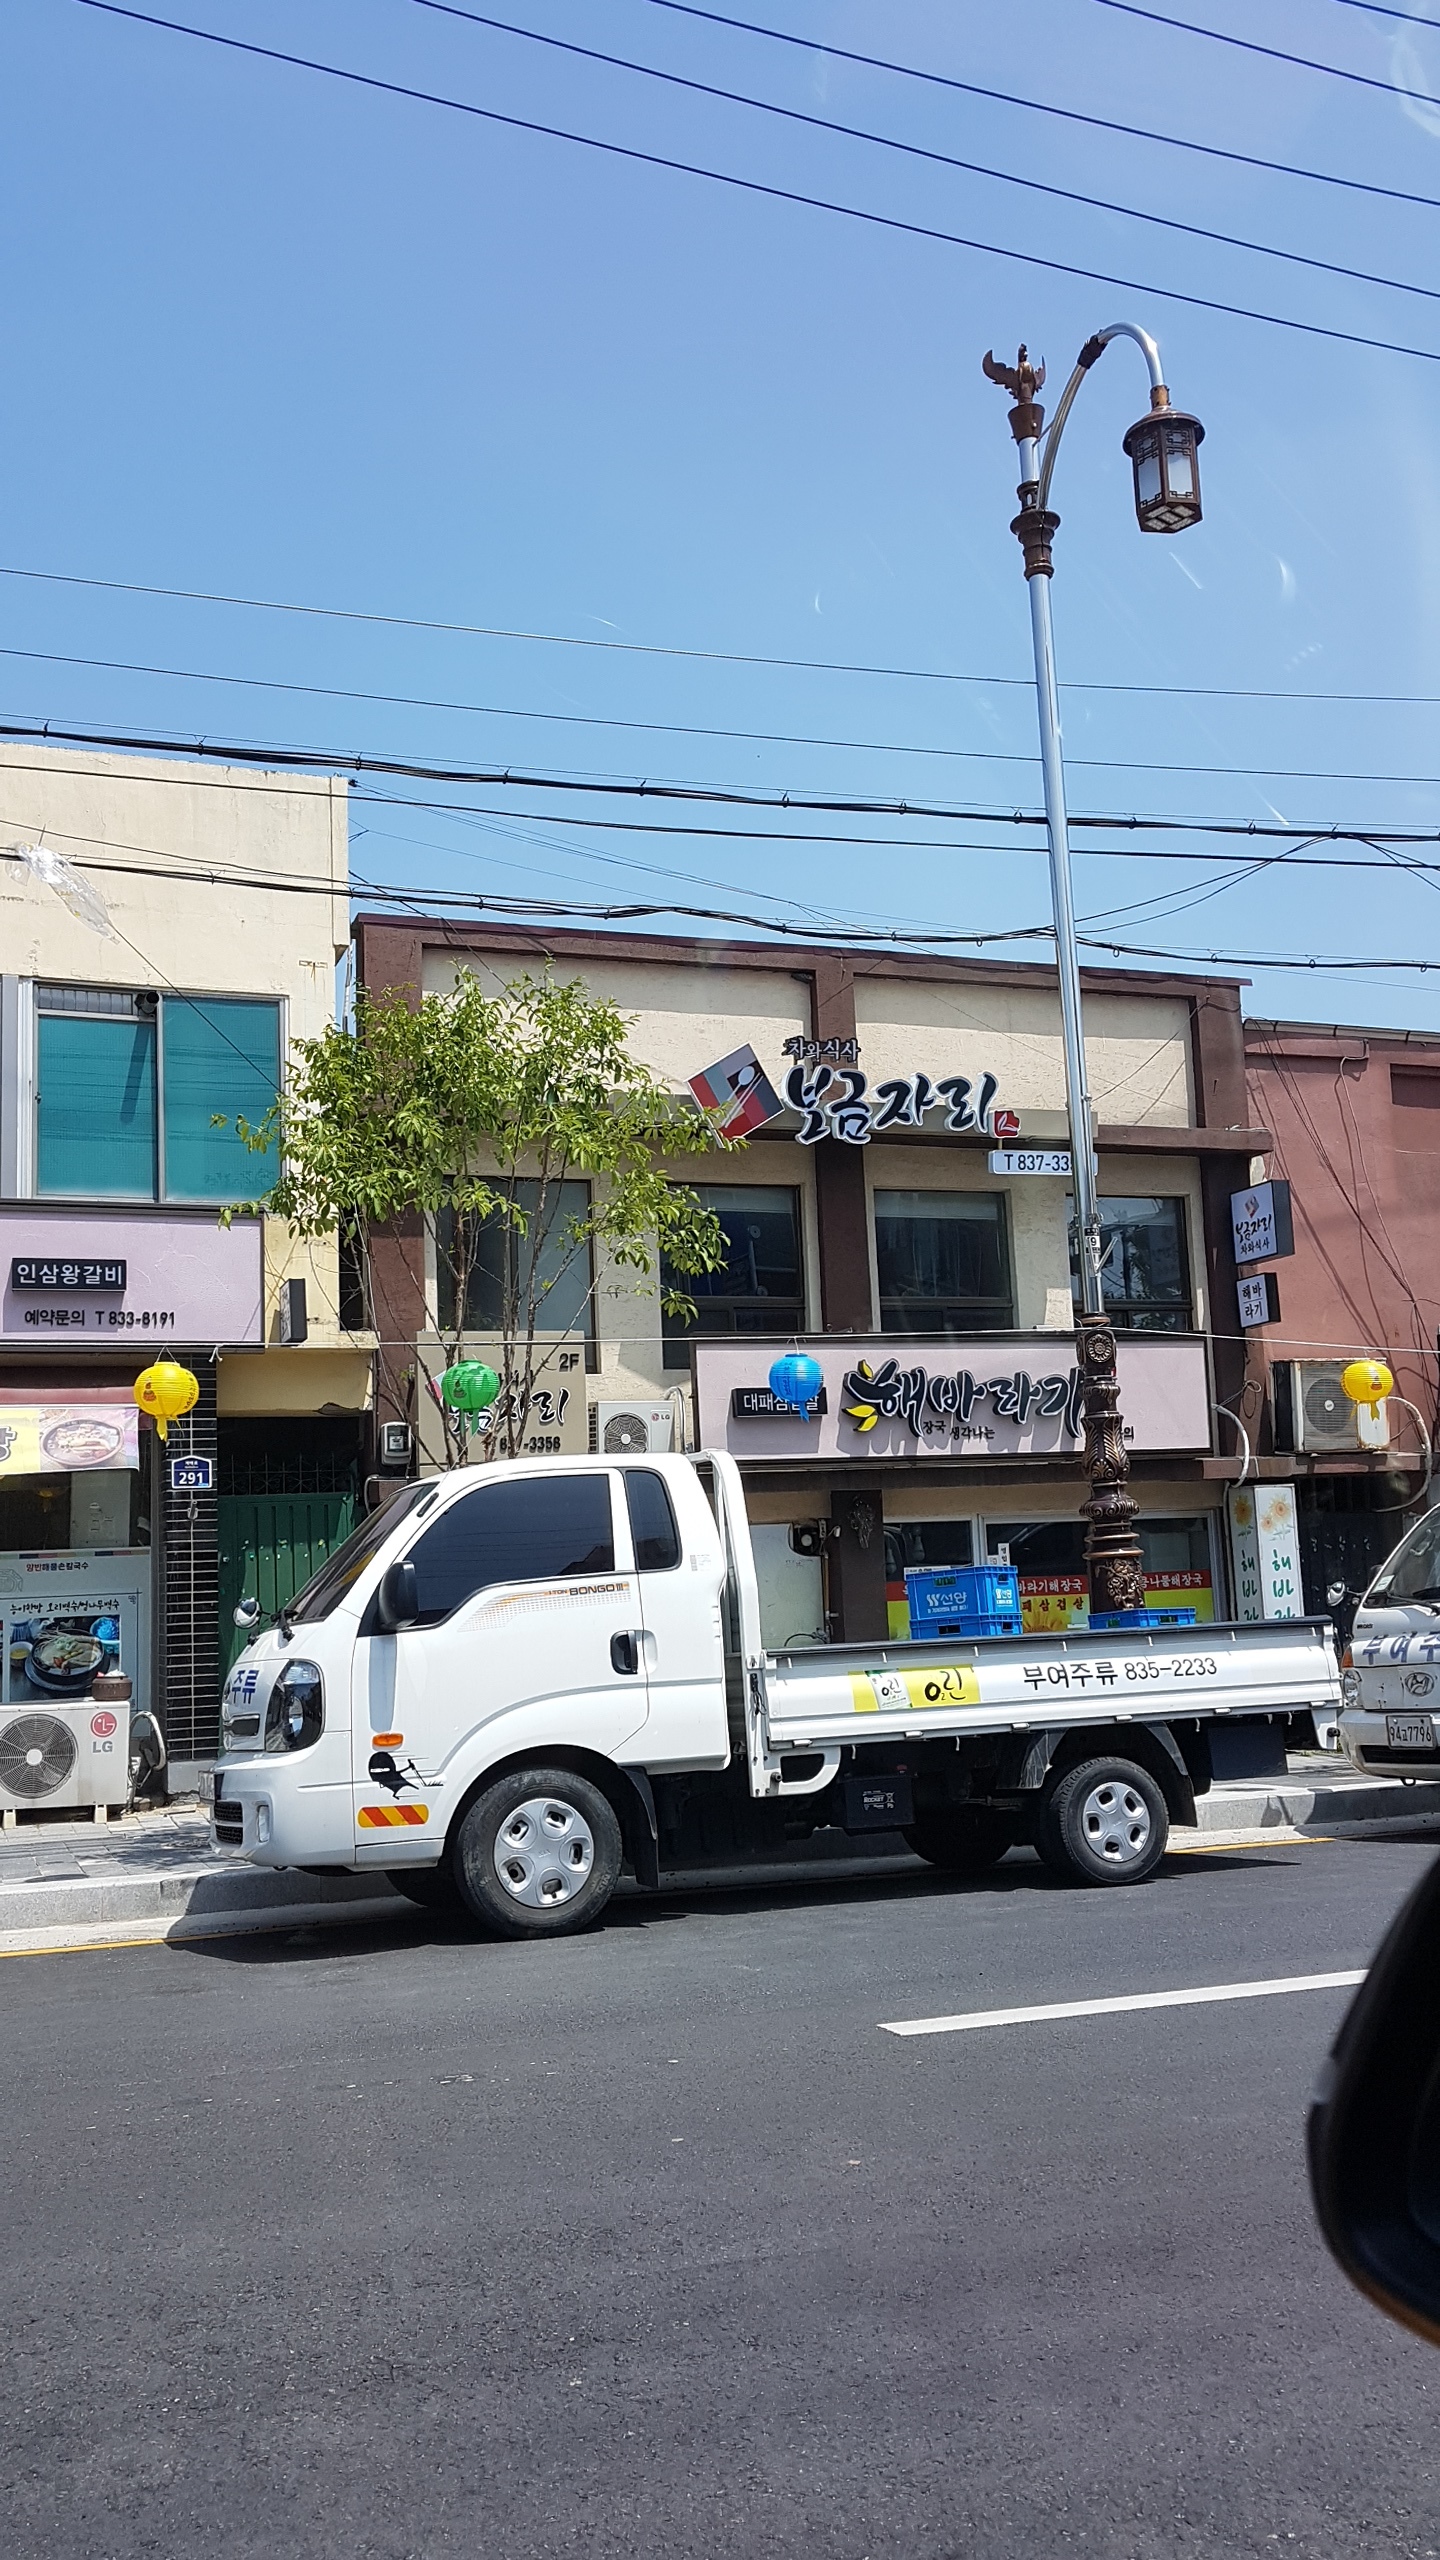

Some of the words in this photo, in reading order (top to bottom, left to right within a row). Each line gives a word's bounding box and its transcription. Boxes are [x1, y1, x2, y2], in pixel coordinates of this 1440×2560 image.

[786, 1036, 860, 1062] 차와식사
[784, 1065, 998, 1144] 보금자리
[1004, 1154, 1014, 1170] T
[1018, 1155, 1073, 1171] 837-33
[1235, 1214, 1272, 1243] 보금자리
[17, 1264, 122, 1285] 인삼왕갈비
[25, 1309, 85, 1326] 예약문의
[95, 1311, 105, 1325] T
[109, 1311, 175, 1328] 833-8191
[559, 1353, 580, 1371] 2F
[950, 1426, 996, 1441] 생각나는
[499, 1437, 561, 1453] 8-3358
[179, 1472, 203, 1484] 291
[569, 1584, 615, 1596] BONGO
[940, 1592, 967, 1606] 선양
[1024, 1661, 1118, 1690] 부여주류
[1124, 1658, 1217, 1681] 835-2233
[231, 1670, 259, 1705] 주류
[92, 1741, 113, 1753] LG
